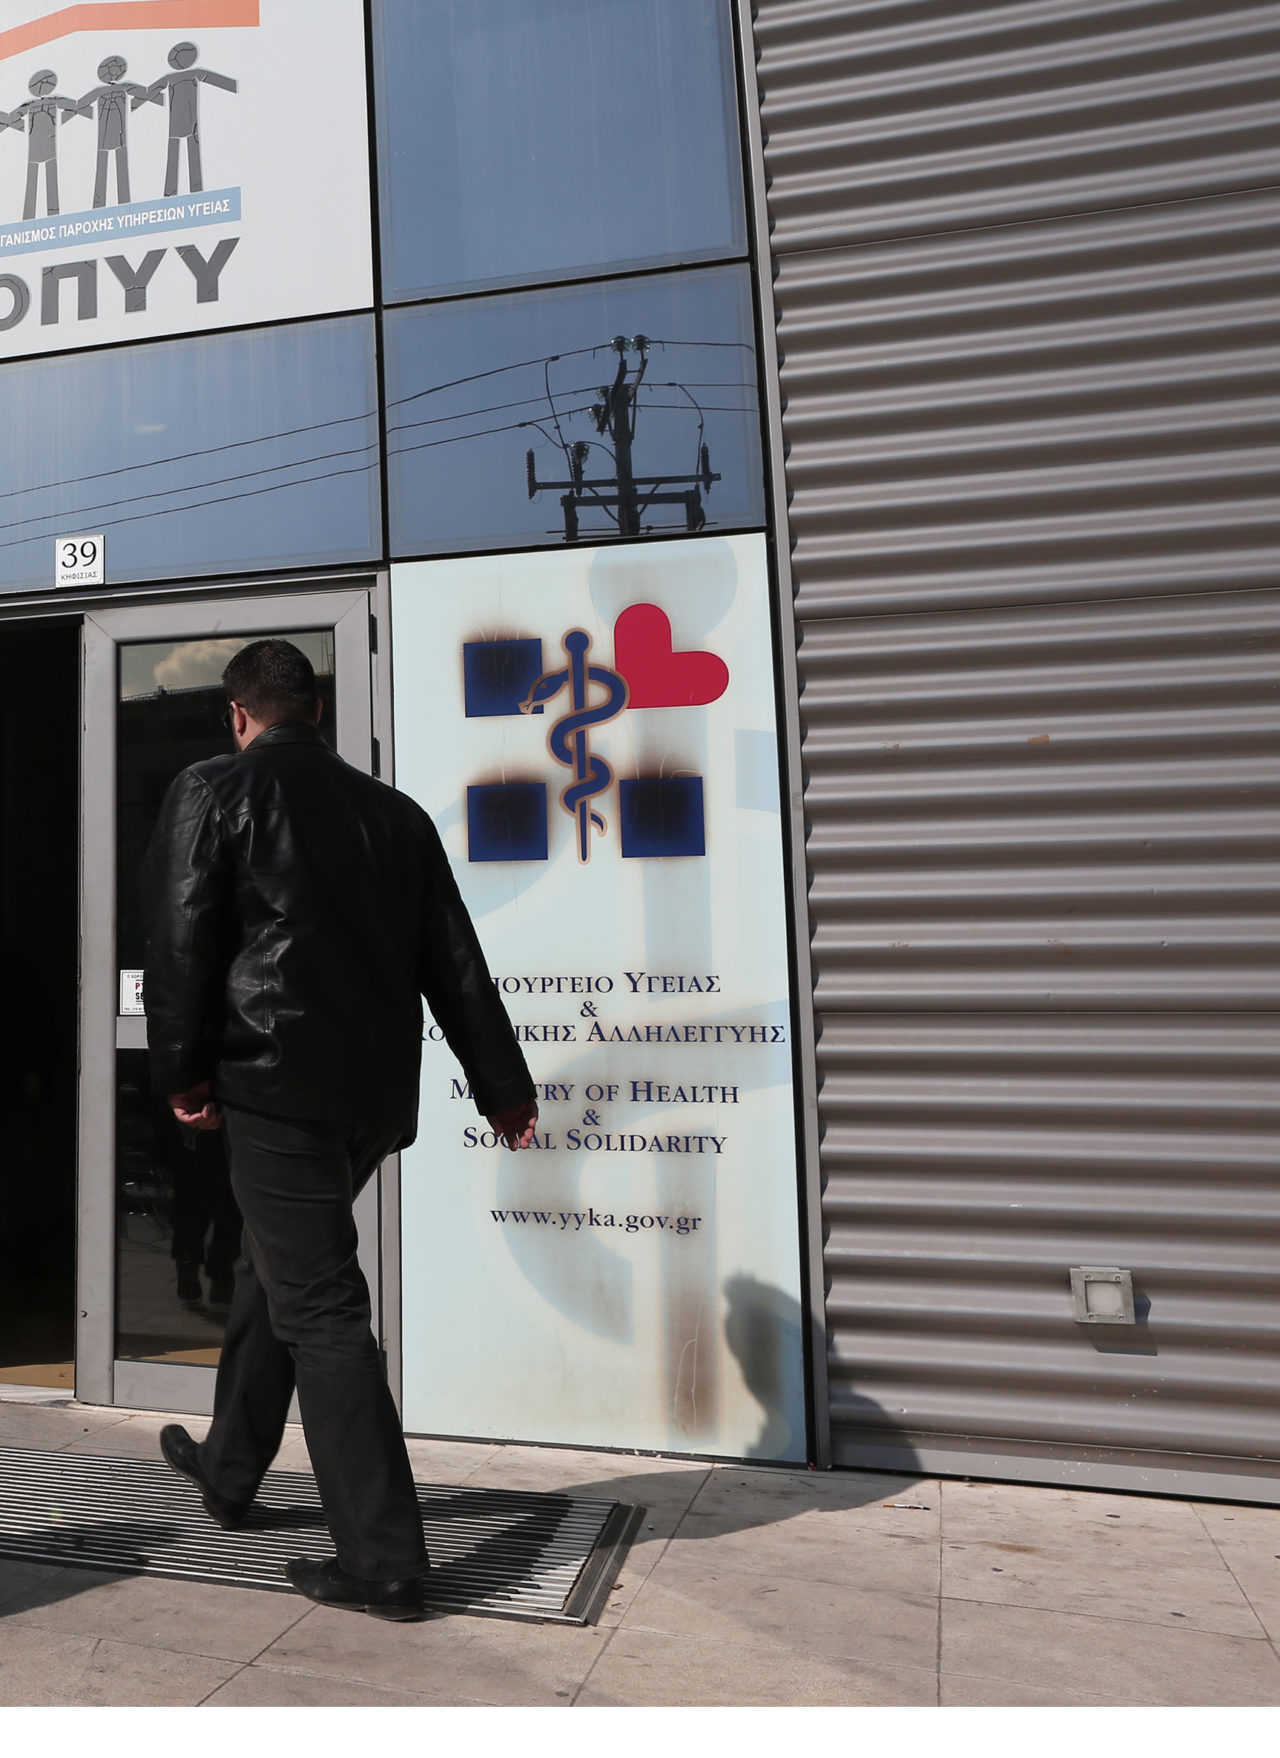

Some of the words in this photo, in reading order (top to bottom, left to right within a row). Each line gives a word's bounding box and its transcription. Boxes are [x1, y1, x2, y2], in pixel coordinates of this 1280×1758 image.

[58, 216, 115, 238] ΠΑΡΟΧΗΣ
[116, 206, 185, 228] ΥΠΗΡΕΣΙΩΝ
[187, 198, 231, 217] ΥΓΕΙΑΣ
[61, 540, 97, 569] 39
[60, 571, 98, 581] ΚΗΦΙΣΙΑΣ
[623, 972, 722, 994] ΥΓΕΙΑΣ
[579, 1000, 599, 1018] &
[586, 1020, 786, 1044] ΑΛΛΗΛΕΓΓΥΗΣ
[585, 1083, 620, 1102] OF
[629, 1080, 740, 1103] HEALTH
[582, 1108, 601, 1126] &
[566, 1128, 728, 1154] SOLIDARITY
[489, 1207, 702, 1235] www.yyka.gov.gr
